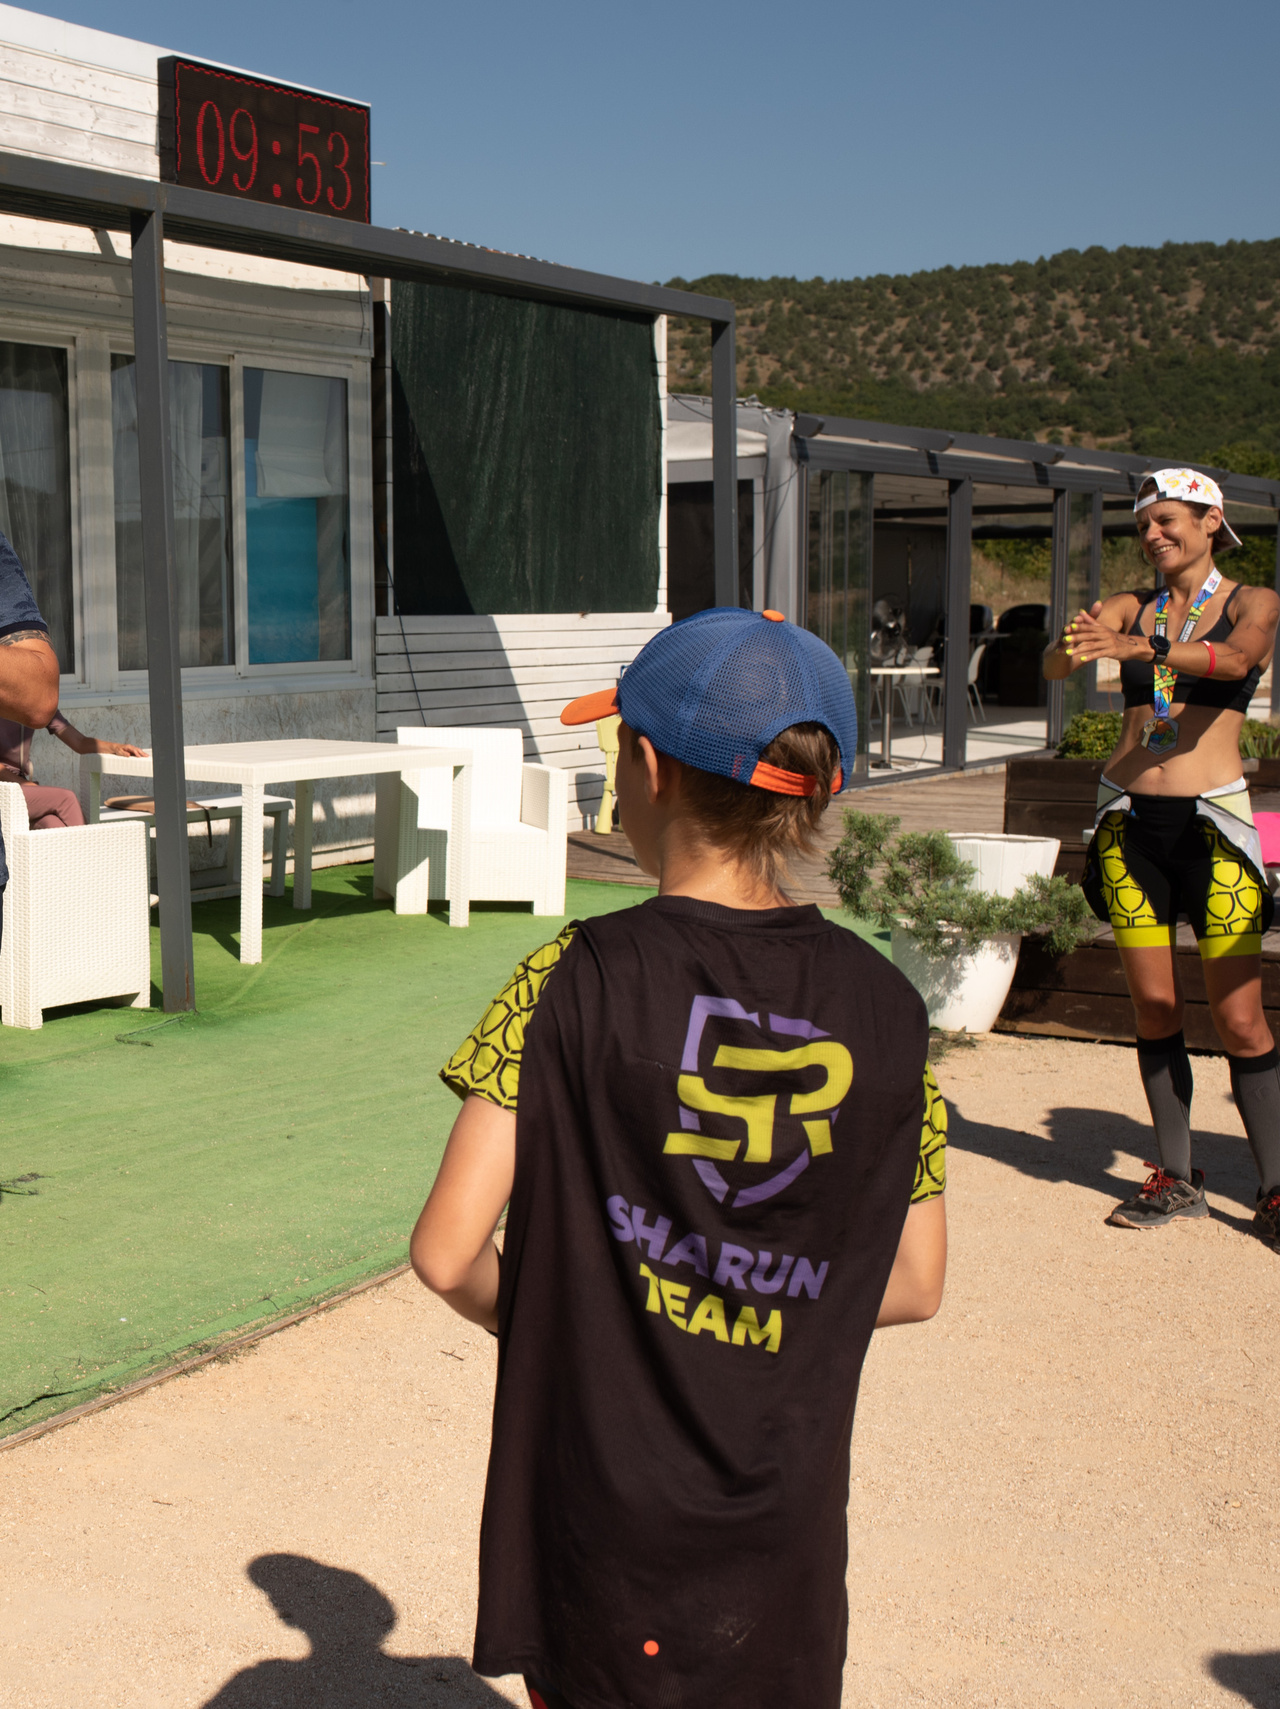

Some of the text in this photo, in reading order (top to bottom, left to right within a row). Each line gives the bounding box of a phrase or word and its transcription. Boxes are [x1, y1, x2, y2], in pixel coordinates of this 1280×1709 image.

[196, 101, 352, 211] 09:53
[606, 1195, 830, 1300] SHARUN
[639, 1263, 782, 1354] TEAM
